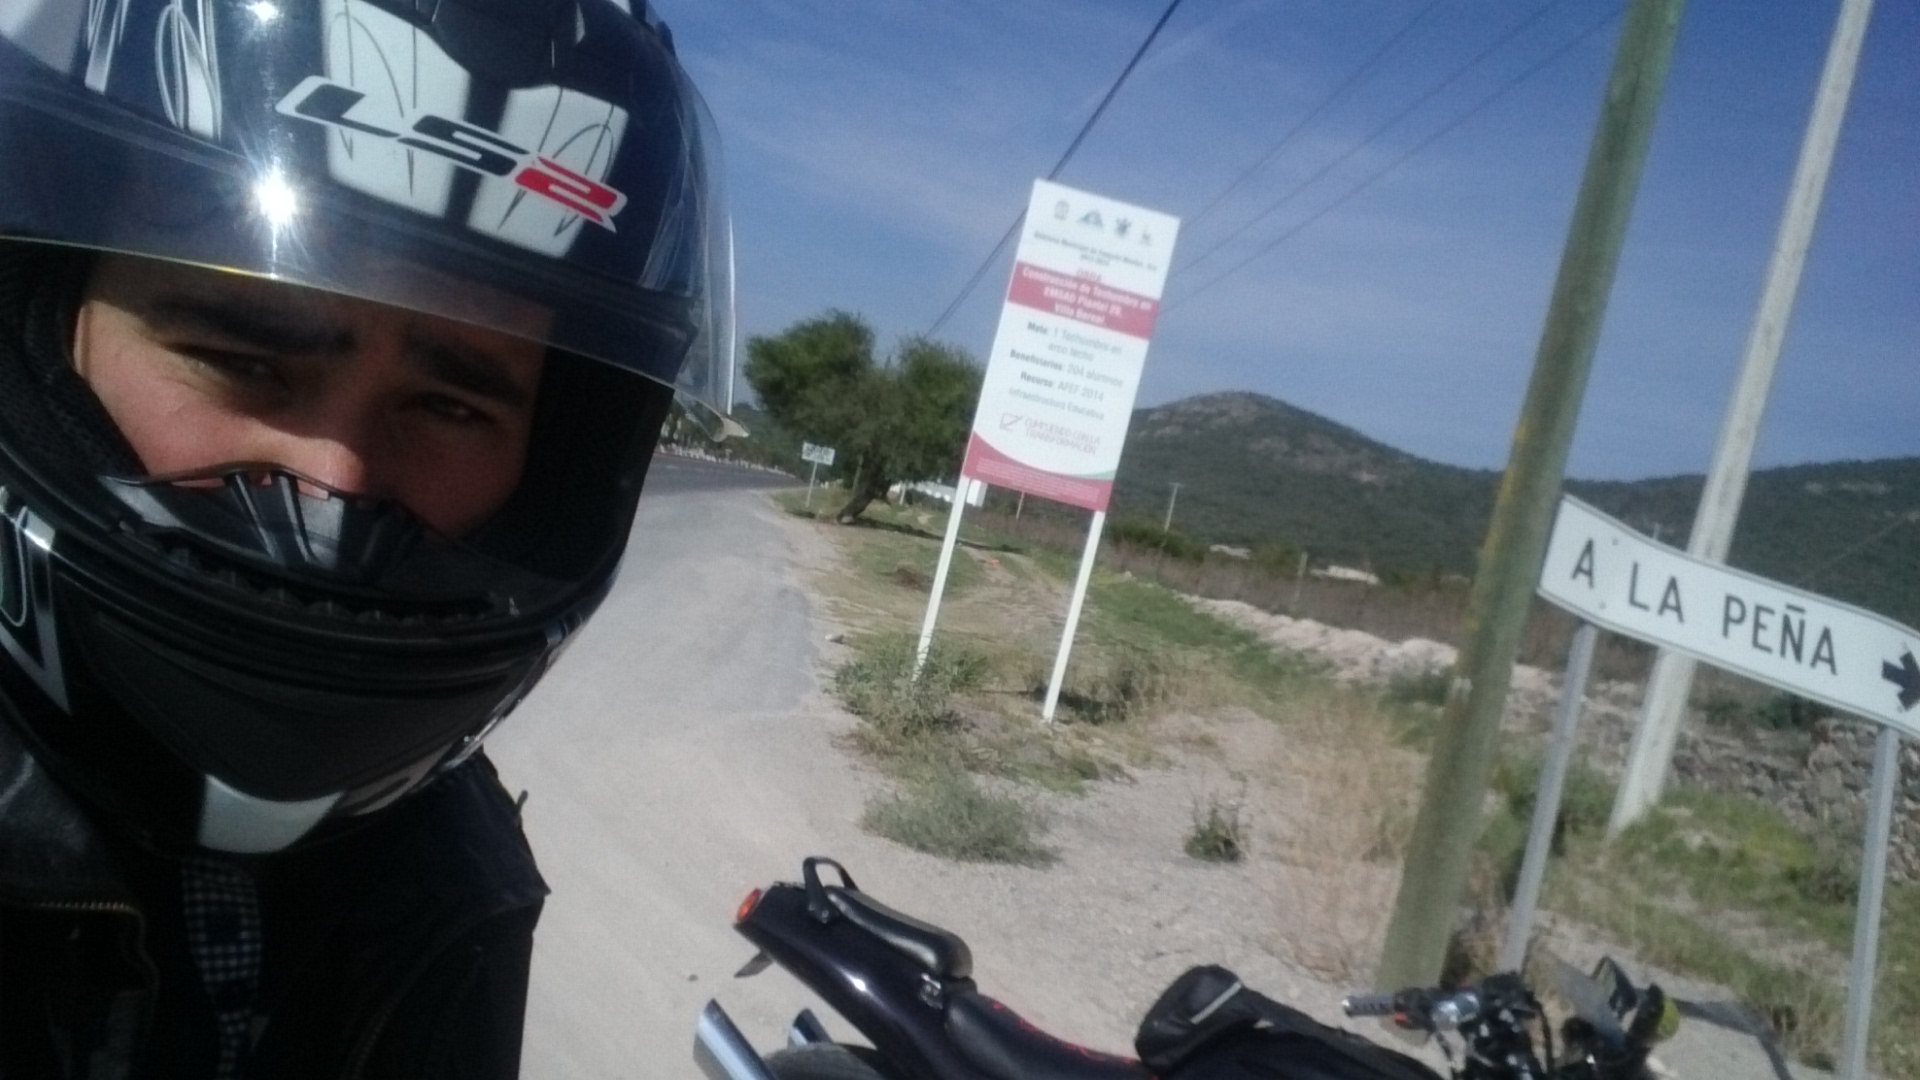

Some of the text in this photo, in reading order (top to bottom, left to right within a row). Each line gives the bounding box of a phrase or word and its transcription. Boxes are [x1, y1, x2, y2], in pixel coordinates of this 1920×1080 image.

[275, 76, 628, 232] LS2
[1079, 283, 1090, 293] de
[1054, 302, 1074, 315] Villa
[1081, 387, 1103, 400] 2014
[1571, 538, 1837, 676] A LA PEÑA
